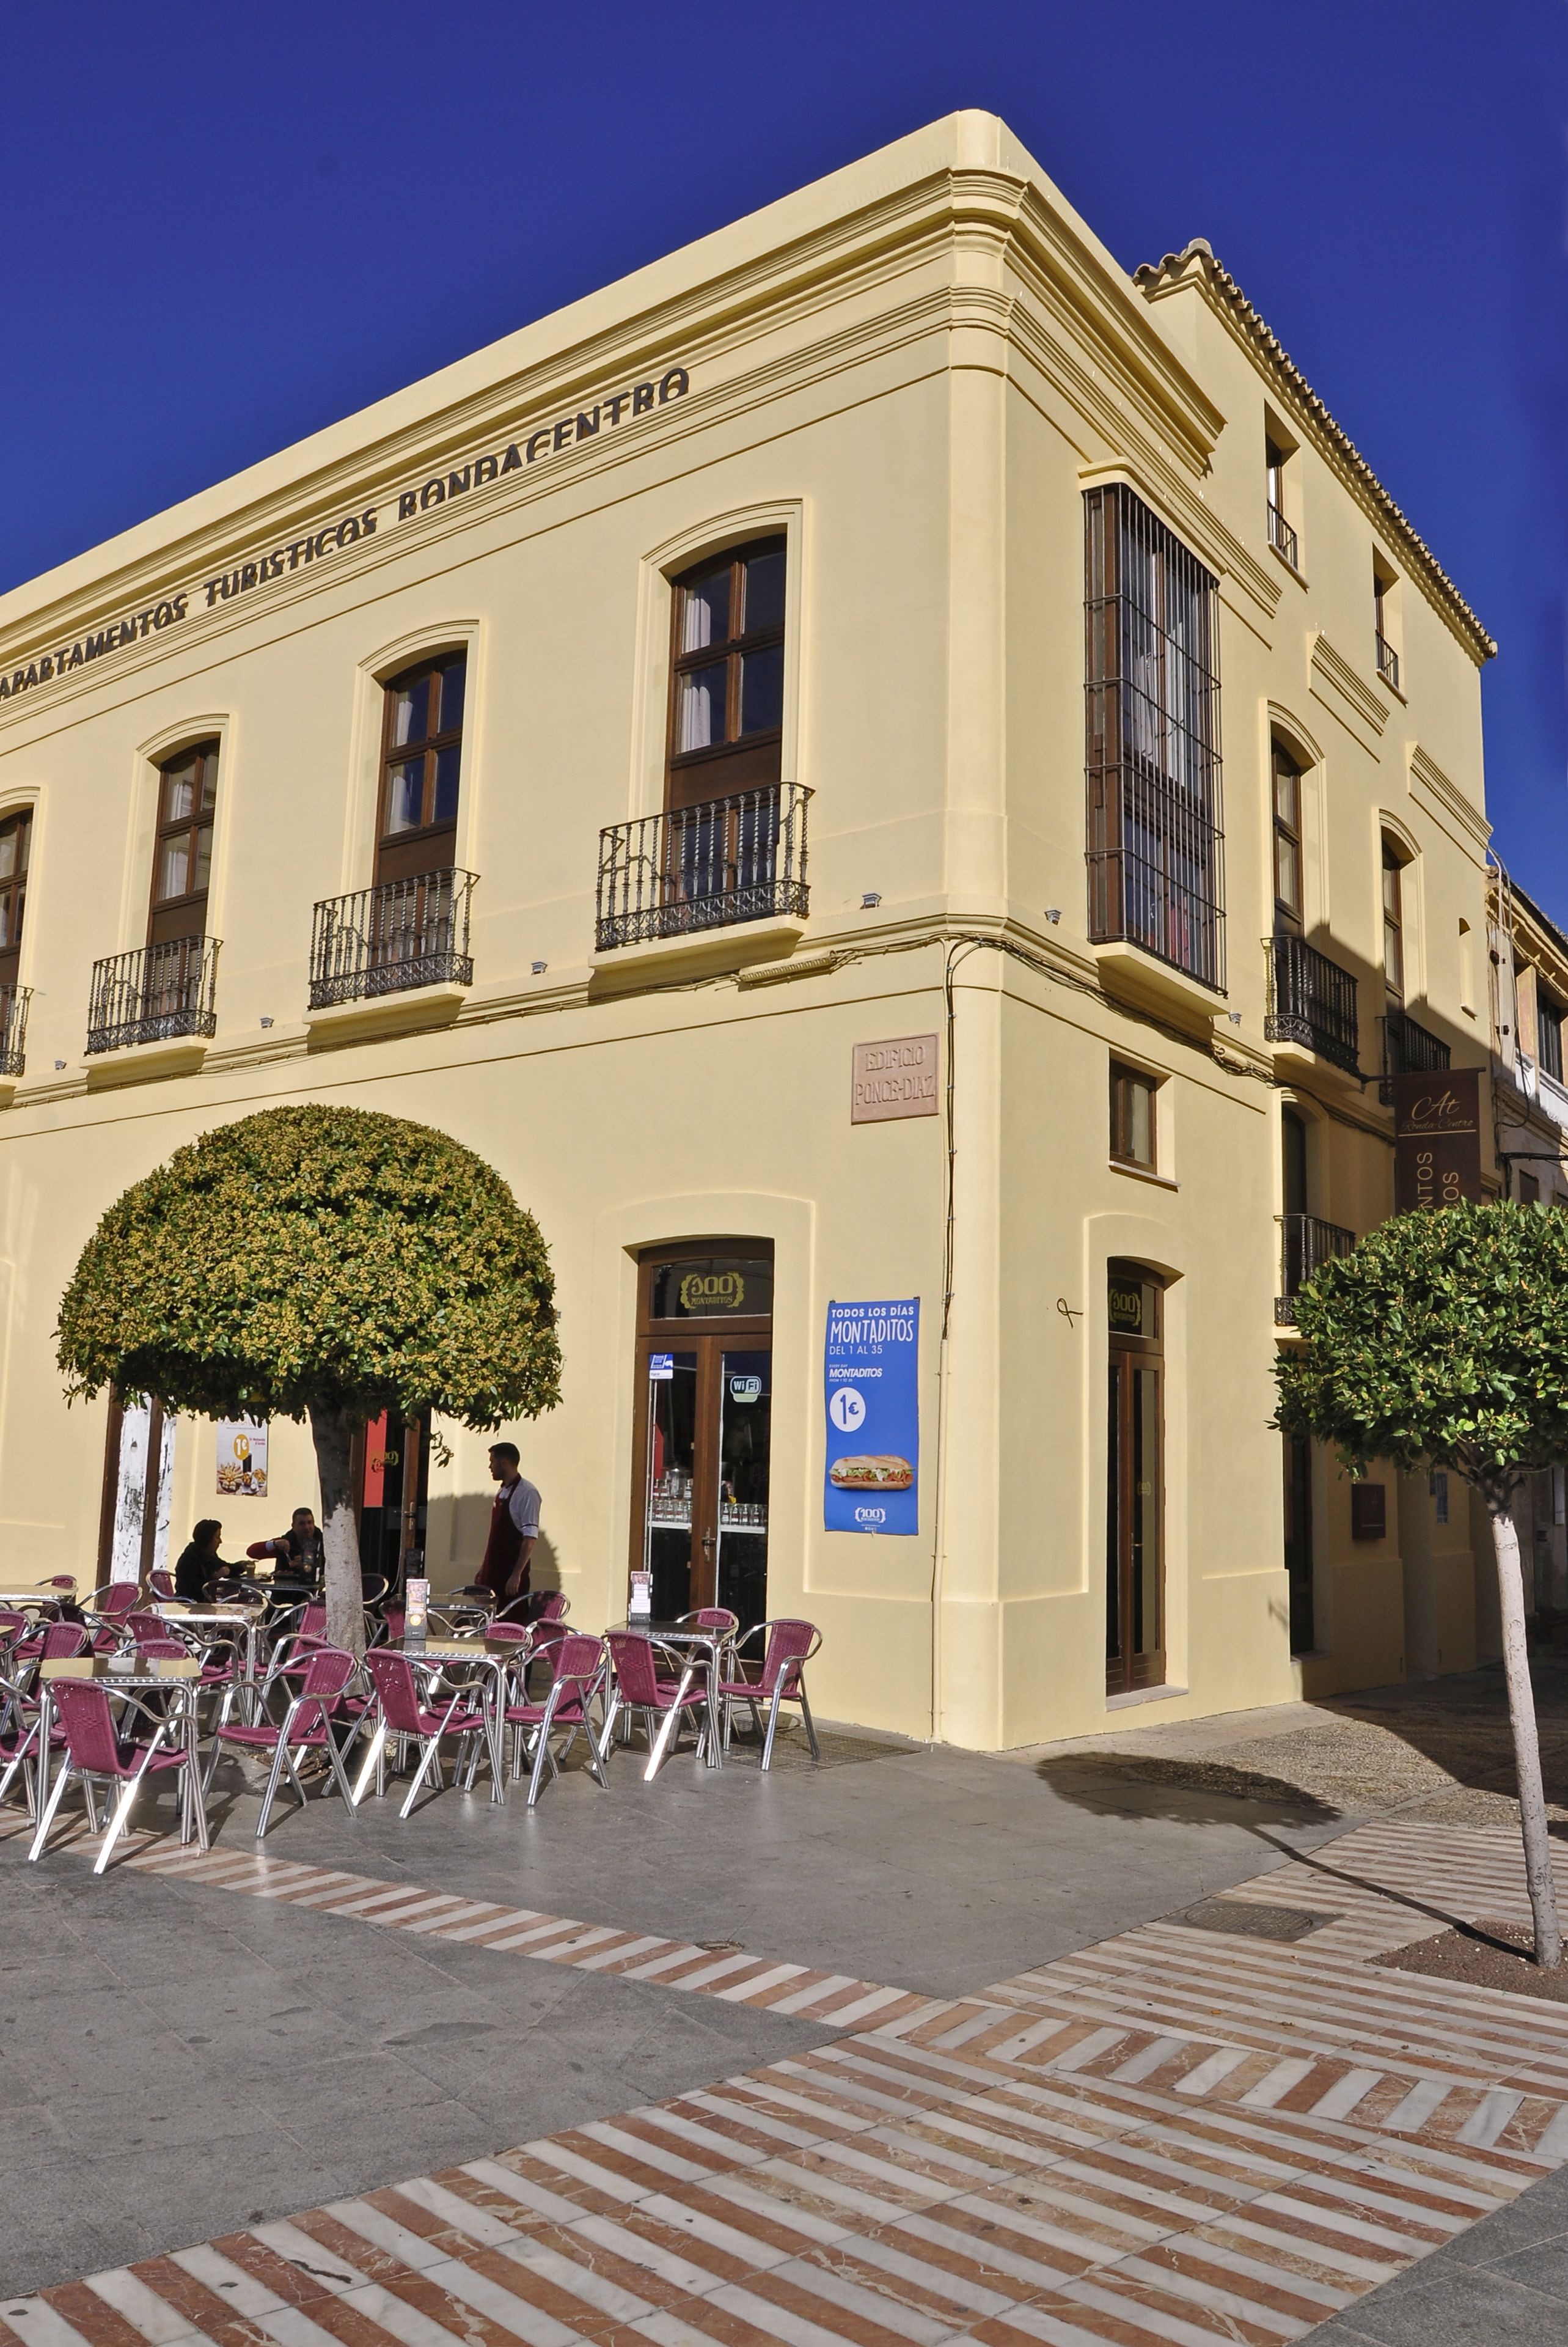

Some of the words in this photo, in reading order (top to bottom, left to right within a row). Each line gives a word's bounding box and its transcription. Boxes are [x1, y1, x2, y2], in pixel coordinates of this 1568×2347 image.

[0, 593, 187, 702] APARTAMENTOS
[203, 508, 376, 608] TURISTICOS
[398, 367, 689, 521] RONDACENTRO
[865, 1046, 924, 1071] EDIFICIO
[832, 1308, 865, 1318] TODOS
[868, 1307, 887, 1317] LOS
[890, 1304, 914, 1316] DÍAS
[830, 1319, 914, 1345] MONTADITOS
[829, 1346, 846, 1355] DEL
[849, 1345, 853, 1354] 1
[857, 1345, 868, 1354] AL
[871, 1345, 883, 1354] 35
[829, 1368, 883, 1378] MONTADITOS
[840, 1394, 859, 1425] 1€
